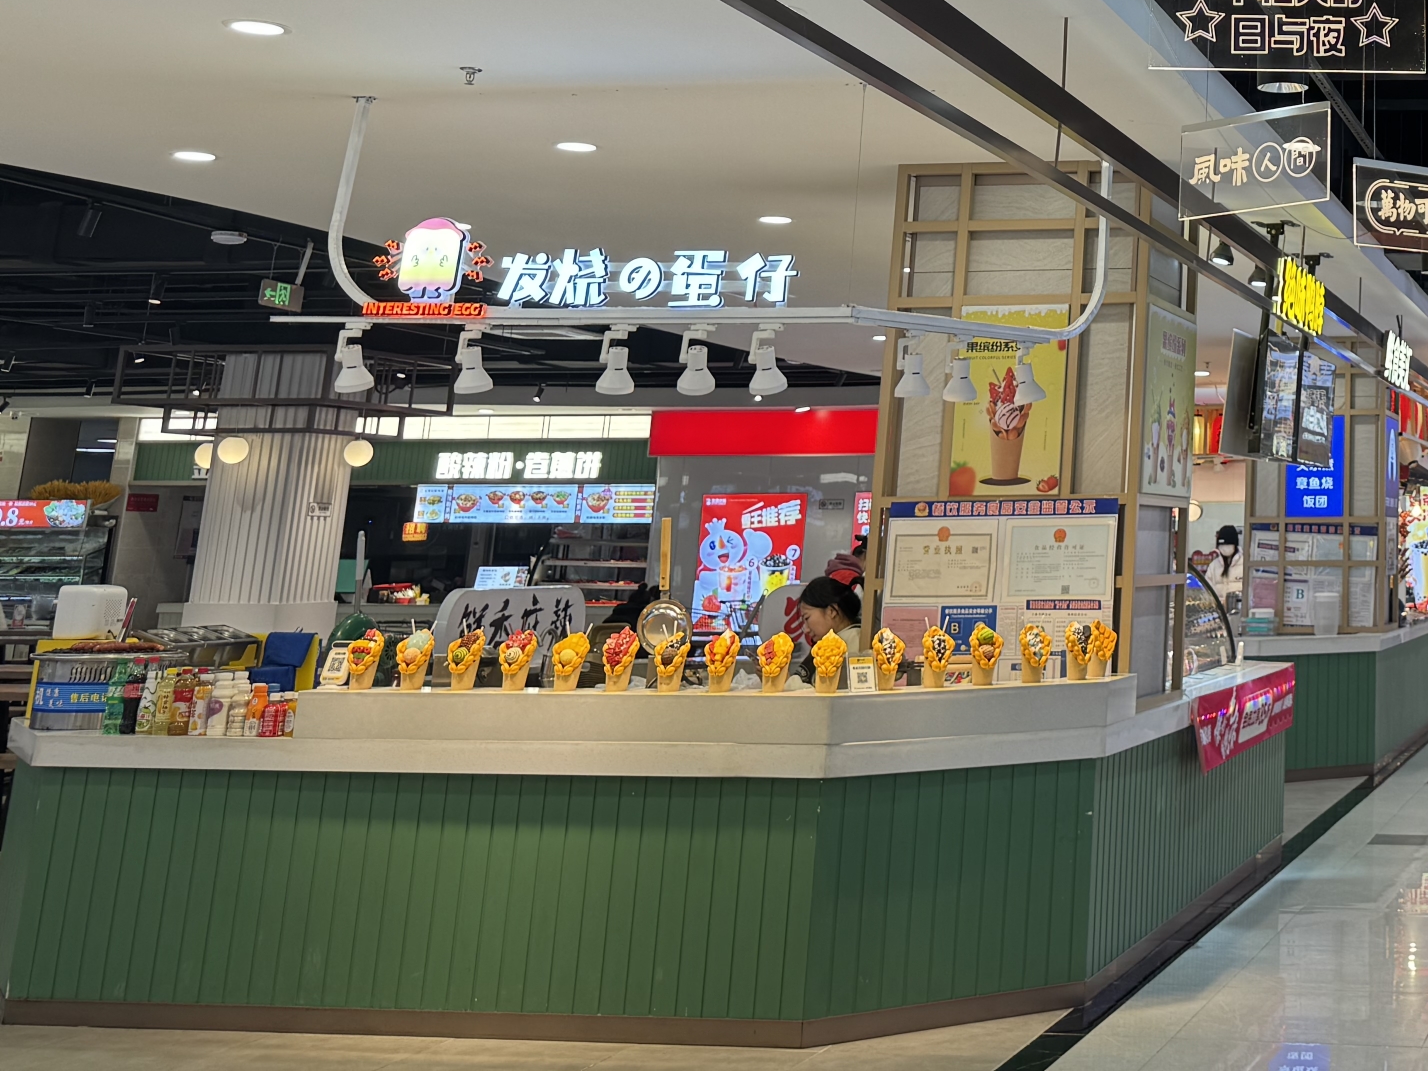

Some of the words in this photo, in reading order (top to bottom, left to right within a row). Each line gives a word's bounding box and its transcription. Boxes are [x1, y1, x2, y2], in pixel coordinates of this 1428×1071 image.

[1231, 14, 1346, 57] 日与夜
[500, 247, 799, 307] 发烧の蛋仔
[363, 302, 450, 317] INTERESTING
[451, 303, 482, 317] EGG
[1296, 476, 1334, 490] 章鱼烧
[1303, 495, 1327, 509] 饭团
[1296, 588, 1305, 600] B
[950, 622, 960, 633] B
